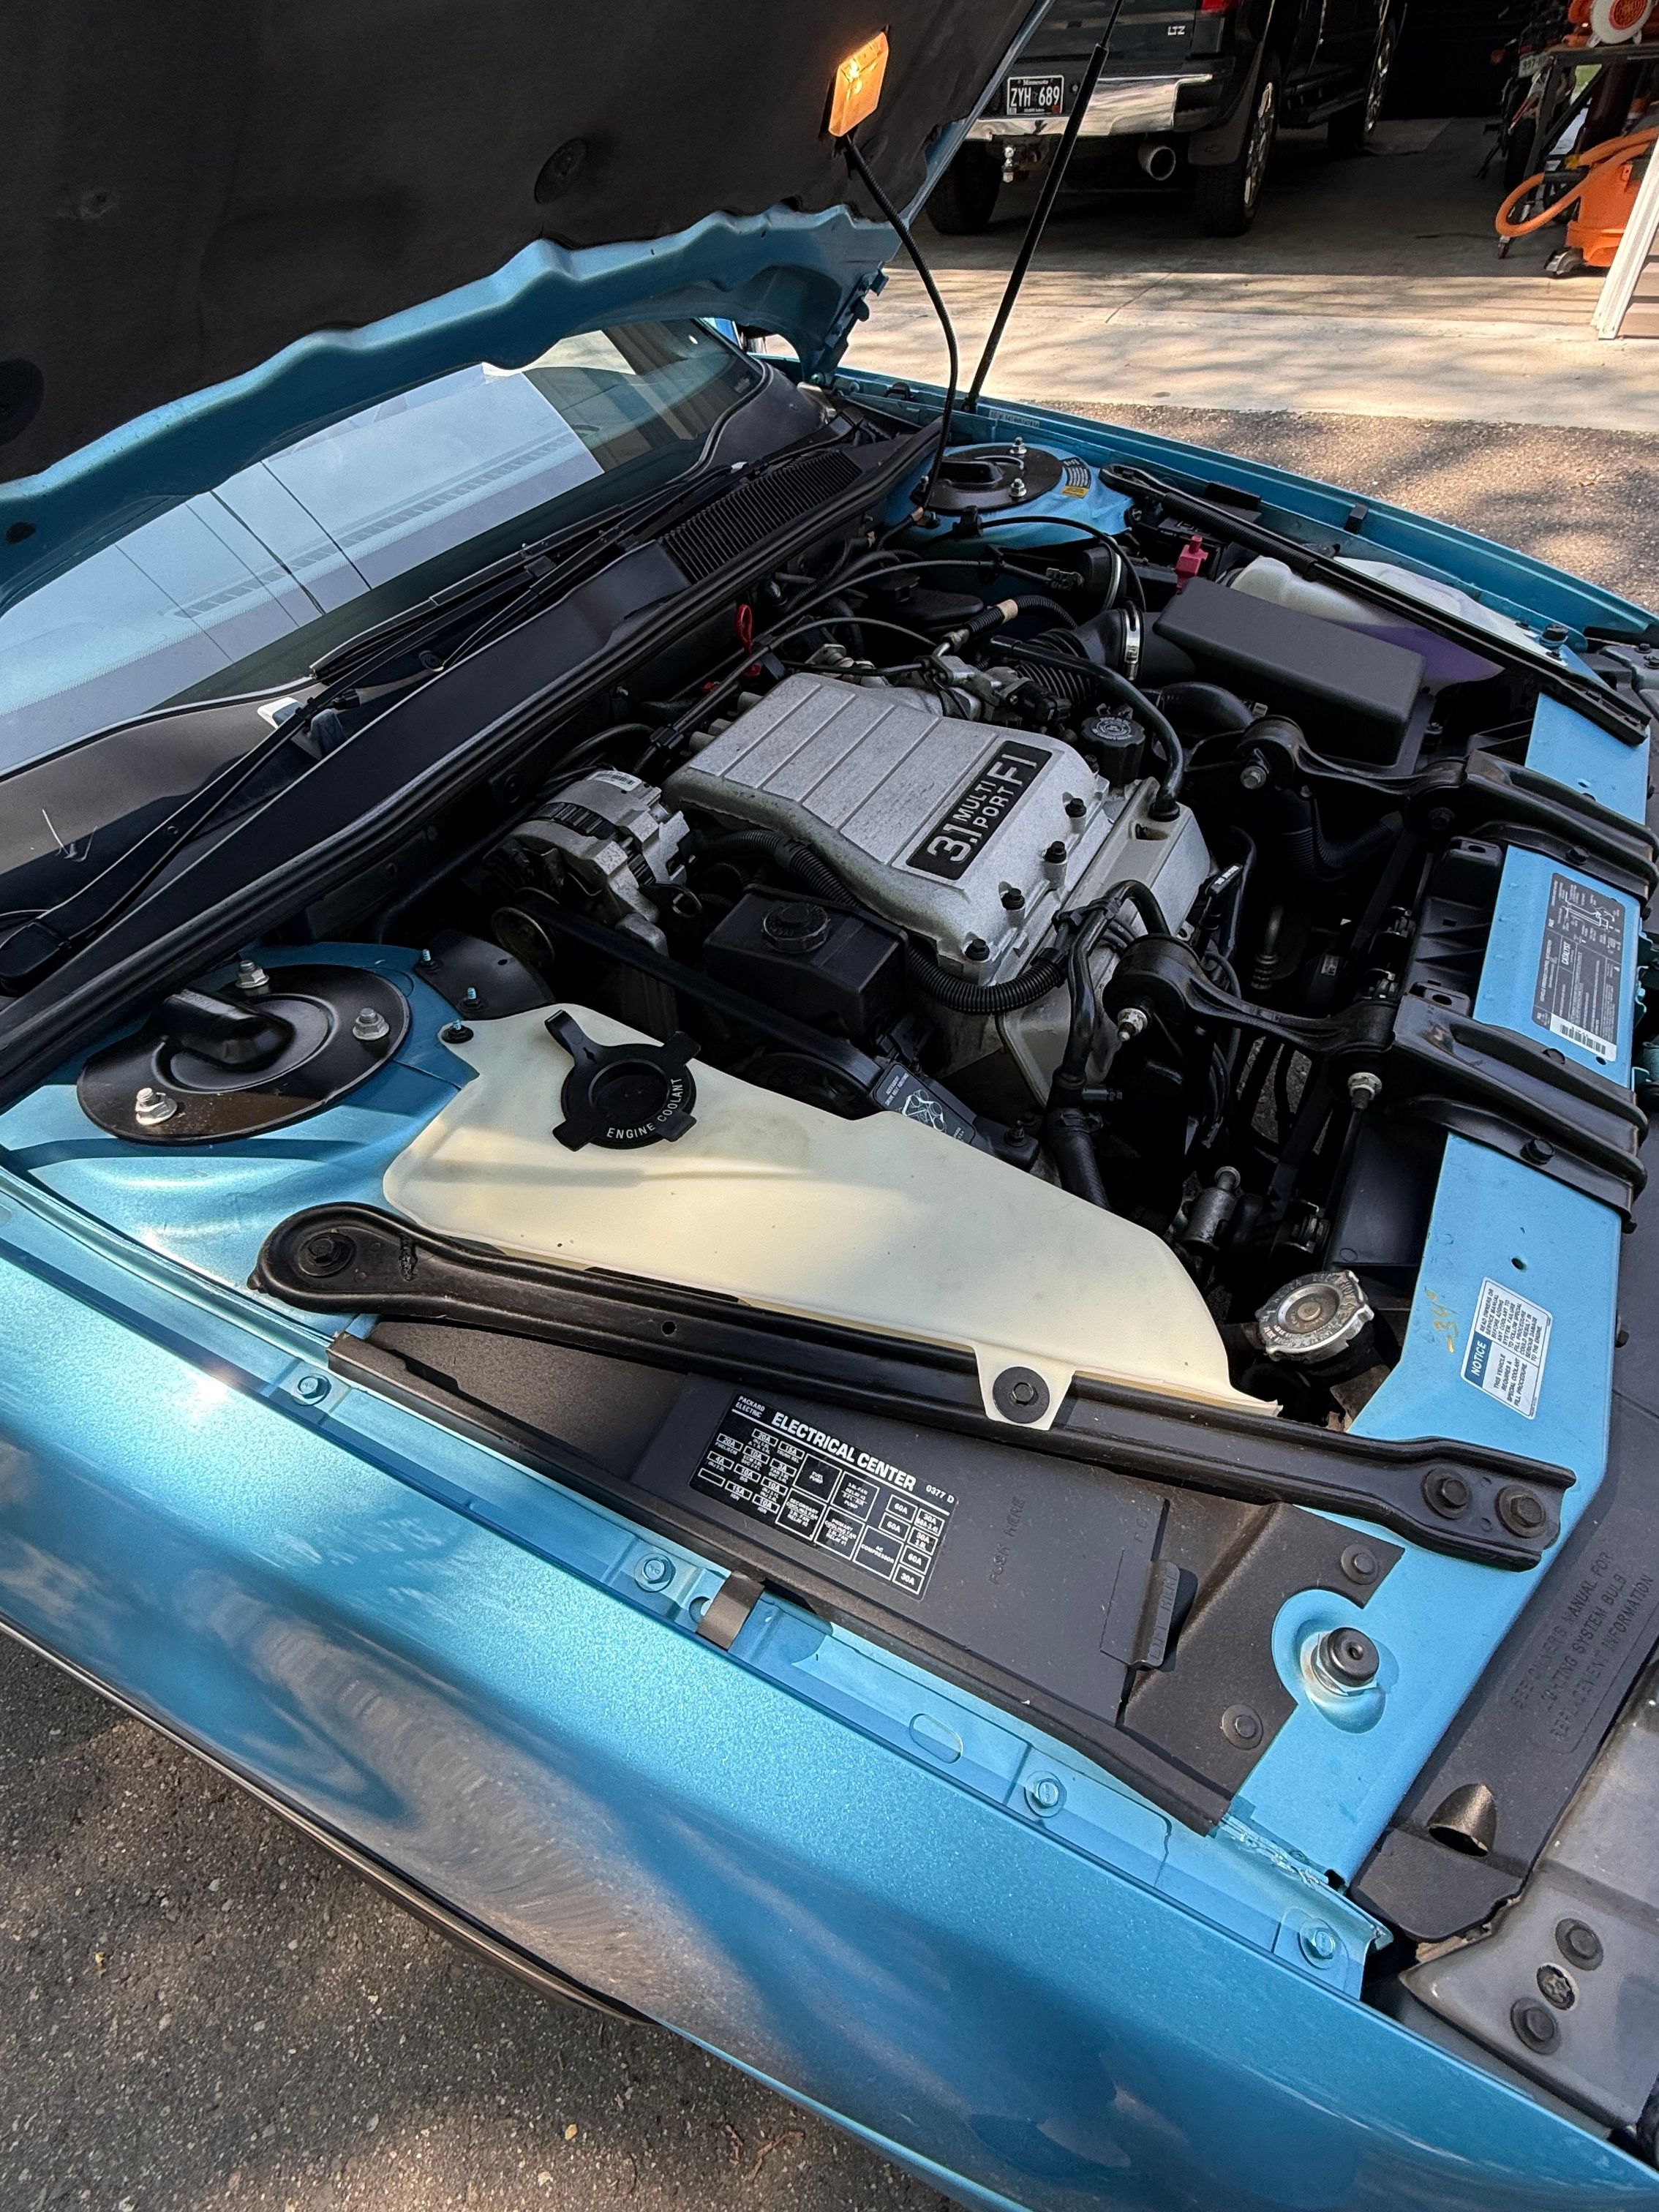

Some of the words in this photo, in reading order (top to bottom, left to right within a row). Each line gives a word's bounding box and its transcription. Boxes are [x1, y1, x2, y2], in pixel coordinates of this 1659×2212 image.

[1167, 26, 1186, 35] LTZ
[1010, 87, 1031, 107] ZYH
[1038, 86, 1060, 106] 689
[988, 753, 1037, 786] FI
[952, 780, 996, 822] MULTI
[973, 786, 1014, 828] PORT
[927, 824, 982, 862] 3.1
[606, 1122, 655, 1140] ENGINE
[657, 1078, 683, 1122] COOLANT
[1479, 1317, 1487, 1331] READ
[1488, 1288, 1494, 1296] OR
[1507, 1303, 1515, 1323] FAILURE
[1513, 1302, 1521, 1321] SPECIAL
[1516, 1310, 1525, 1339] PROCEDURE
[1522, 1320, 1530, 1337] RESULT
[1471, 1340, 1486, 1375] NOTICE
[1497, 1353, 1505, 1376] VEHICLE
[1502, 1365, 1511, 1391] REQUIRES
[1507, 1381, 1515, 1402] SPECIAL
[1511, 1358, 1519, 1381] COOLANT
[735, 1402, 761, 1418] ELECTRIC
[738, 1396, 765, 1411] PACKARD
[723, 1437, 735, 1447] 20A
[758, 1432, 770, 1442] 20A
[749, 1450, 762, 1460] 10A
[771, 1412, 858, 1462] ELECTRICAL
[856, 1452, 917, 1491] CENTER
[715, 1456, 724, 1464] 4A
[778, 1464, 787, 1472] 3A
[740, 1468, 753, 1478] 10A
[732, 1485, 745, 1494] 15A
[767, 1481, 780, 1491] 10A
[925, 1484, 945, 1499] 0377
[947, 1494, 955, 1504] D
[759, 1498, 772, 1508] 10A
[786, 1501, 807, 1514] COOLING
[790, 1498, 818, 1514] SECONDARY
[894, 1502, 908, 1514] 60A
[824, 1520, 846, 1533] COOLING
[832, 1519, 852, 1531] PRIMARY
[887, 1521, 901, 1532] 60A
[923, 1513, 937, 1524] 30A
[916, 1532, 930, 1543] 30A
[861, 1544, 894, 1563] COMPRESSOR
[908, 1553, 922, 1565] 60A
[900, 1573, 915, 1585] 30A
[1563, 1578, 1597, 1622] MANUAL
[1592, 1552, 1613, 1574] FOR
[1159, 1569, 1180, 1611] HERE
[1572, 1606, 1607, 1653] SYSTEM
[1601, 1573, 1626, 1603] BULB
[1602, 1575, 1655, 1648] INFORMATION
